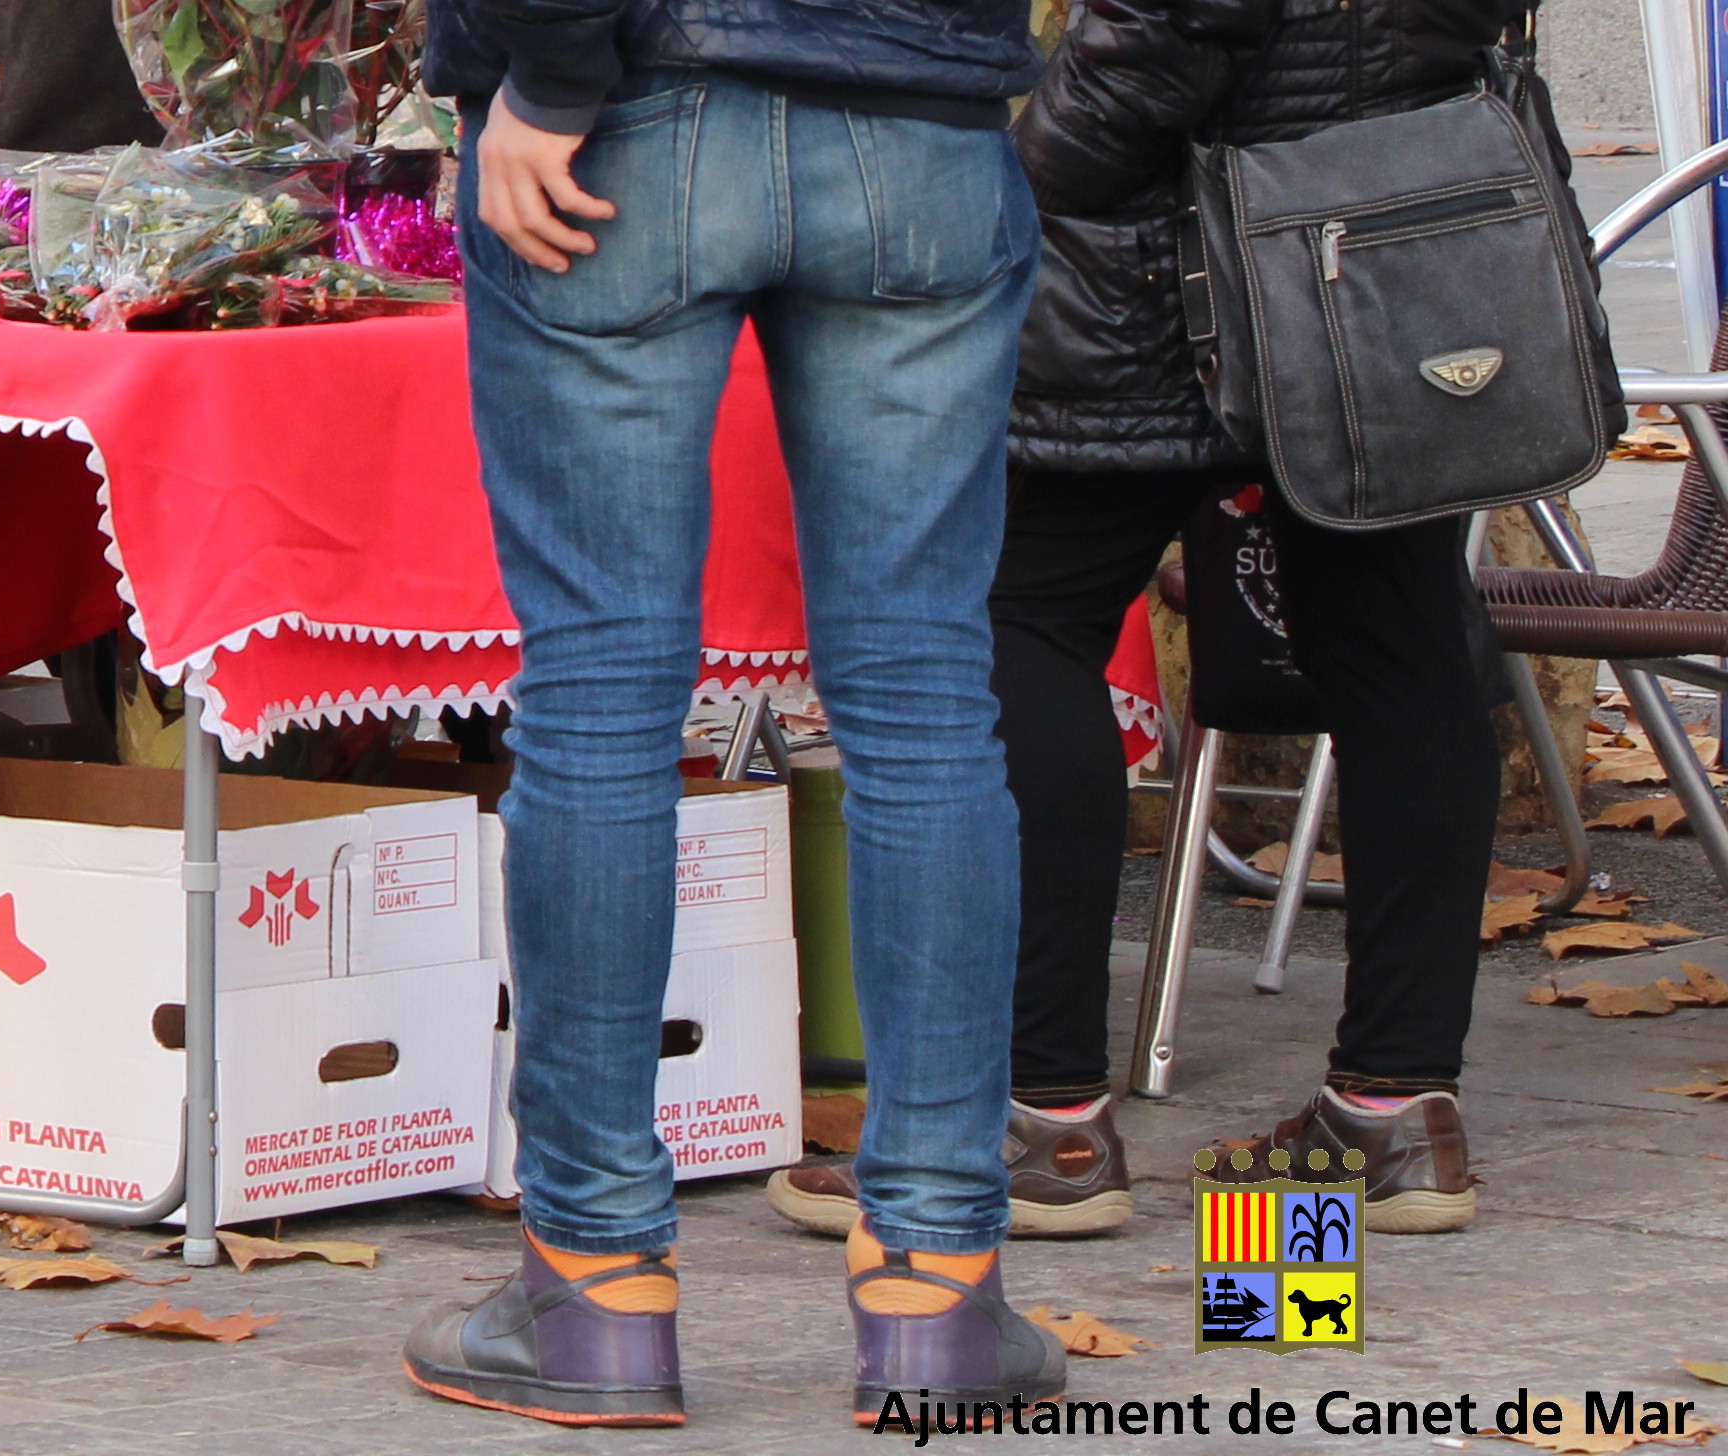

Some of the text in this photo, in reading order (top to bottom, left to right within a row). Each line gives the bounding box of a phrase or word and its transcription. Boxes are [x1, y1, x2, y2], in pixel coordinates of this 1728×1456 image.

[395, 845, 404, 860] P.
[698, 840, 707, 854] P.
[378, 890, 420, 909] QUANT.
[678, 884, 726, 902] QUANT.
[687, 1101, 691, 1118] I
[696, 1094, 760, 1117] PLANTA
[9, 1120, 108, 1154] PLANTA
[244, 1107, 453, 1155] MERCAT DE FLOR I PLANTA
[663, 1112, 785, 1143] DE CATALUNYA
[244, 1126, 475, 1177] ORNAMENTAL DE CATALUNYA
[243, 1154, 456, 1203] www.mercatflor.com
